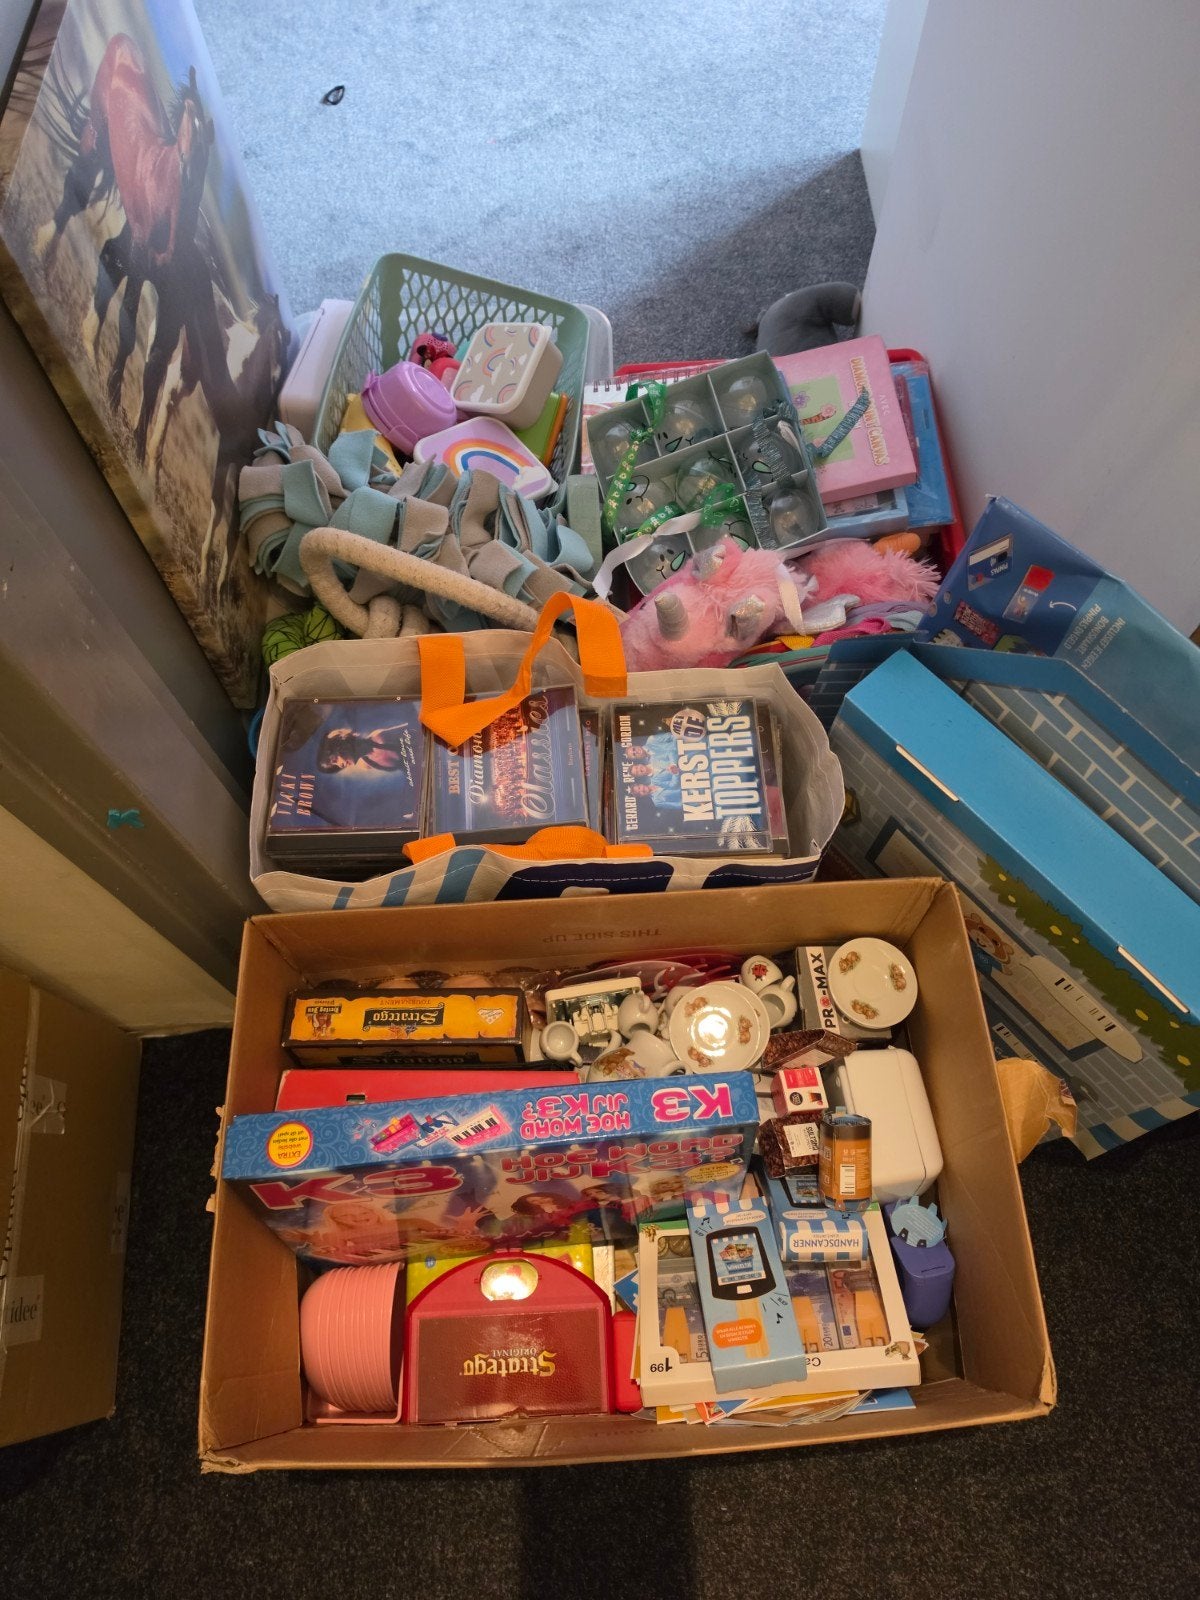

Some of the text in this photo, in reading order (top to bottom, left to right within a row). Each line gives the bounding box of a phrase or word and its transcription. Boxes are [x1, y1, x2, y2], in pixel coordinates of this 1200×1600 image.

[867, 422, 890, 467] CANVAS
[619, 715, 633, 748] GORDON
[683, 716, 704, 738] DE
[521, 695, 556, 819] Classics
[707, 715, 762, 819] TOPPERS
[447, 760, 460, 794] BEST
[677, 739, 714, 821] KERST
[277, 773, 296, 815] VICKI
[297, 773, 315, 816] BROWN
[625, 796, 638, 830] GERARD
[542, 928, 662, 945] THIS SIDE UP
[372, 1010, 439, 1025] Stratego
[521, 1092, 629, 1121] JIJ K3?
[650, 1083, 734, 1123] K3
[519, 1111, 630, 1140] HOE WORD
[277, 1150, 301, 1160] EXTRA
[501, 1133, 744, 1172] HOE WORD
[249, 1163, 464, 1211] K3
[504, 1165, 580, 1185] JIJ
[793, 1238, 859, 1248] HANDSCANNER
[463, 1350, 556, 1378] Stratego
[491, 1347, 537, 1357] ORIGINAL
